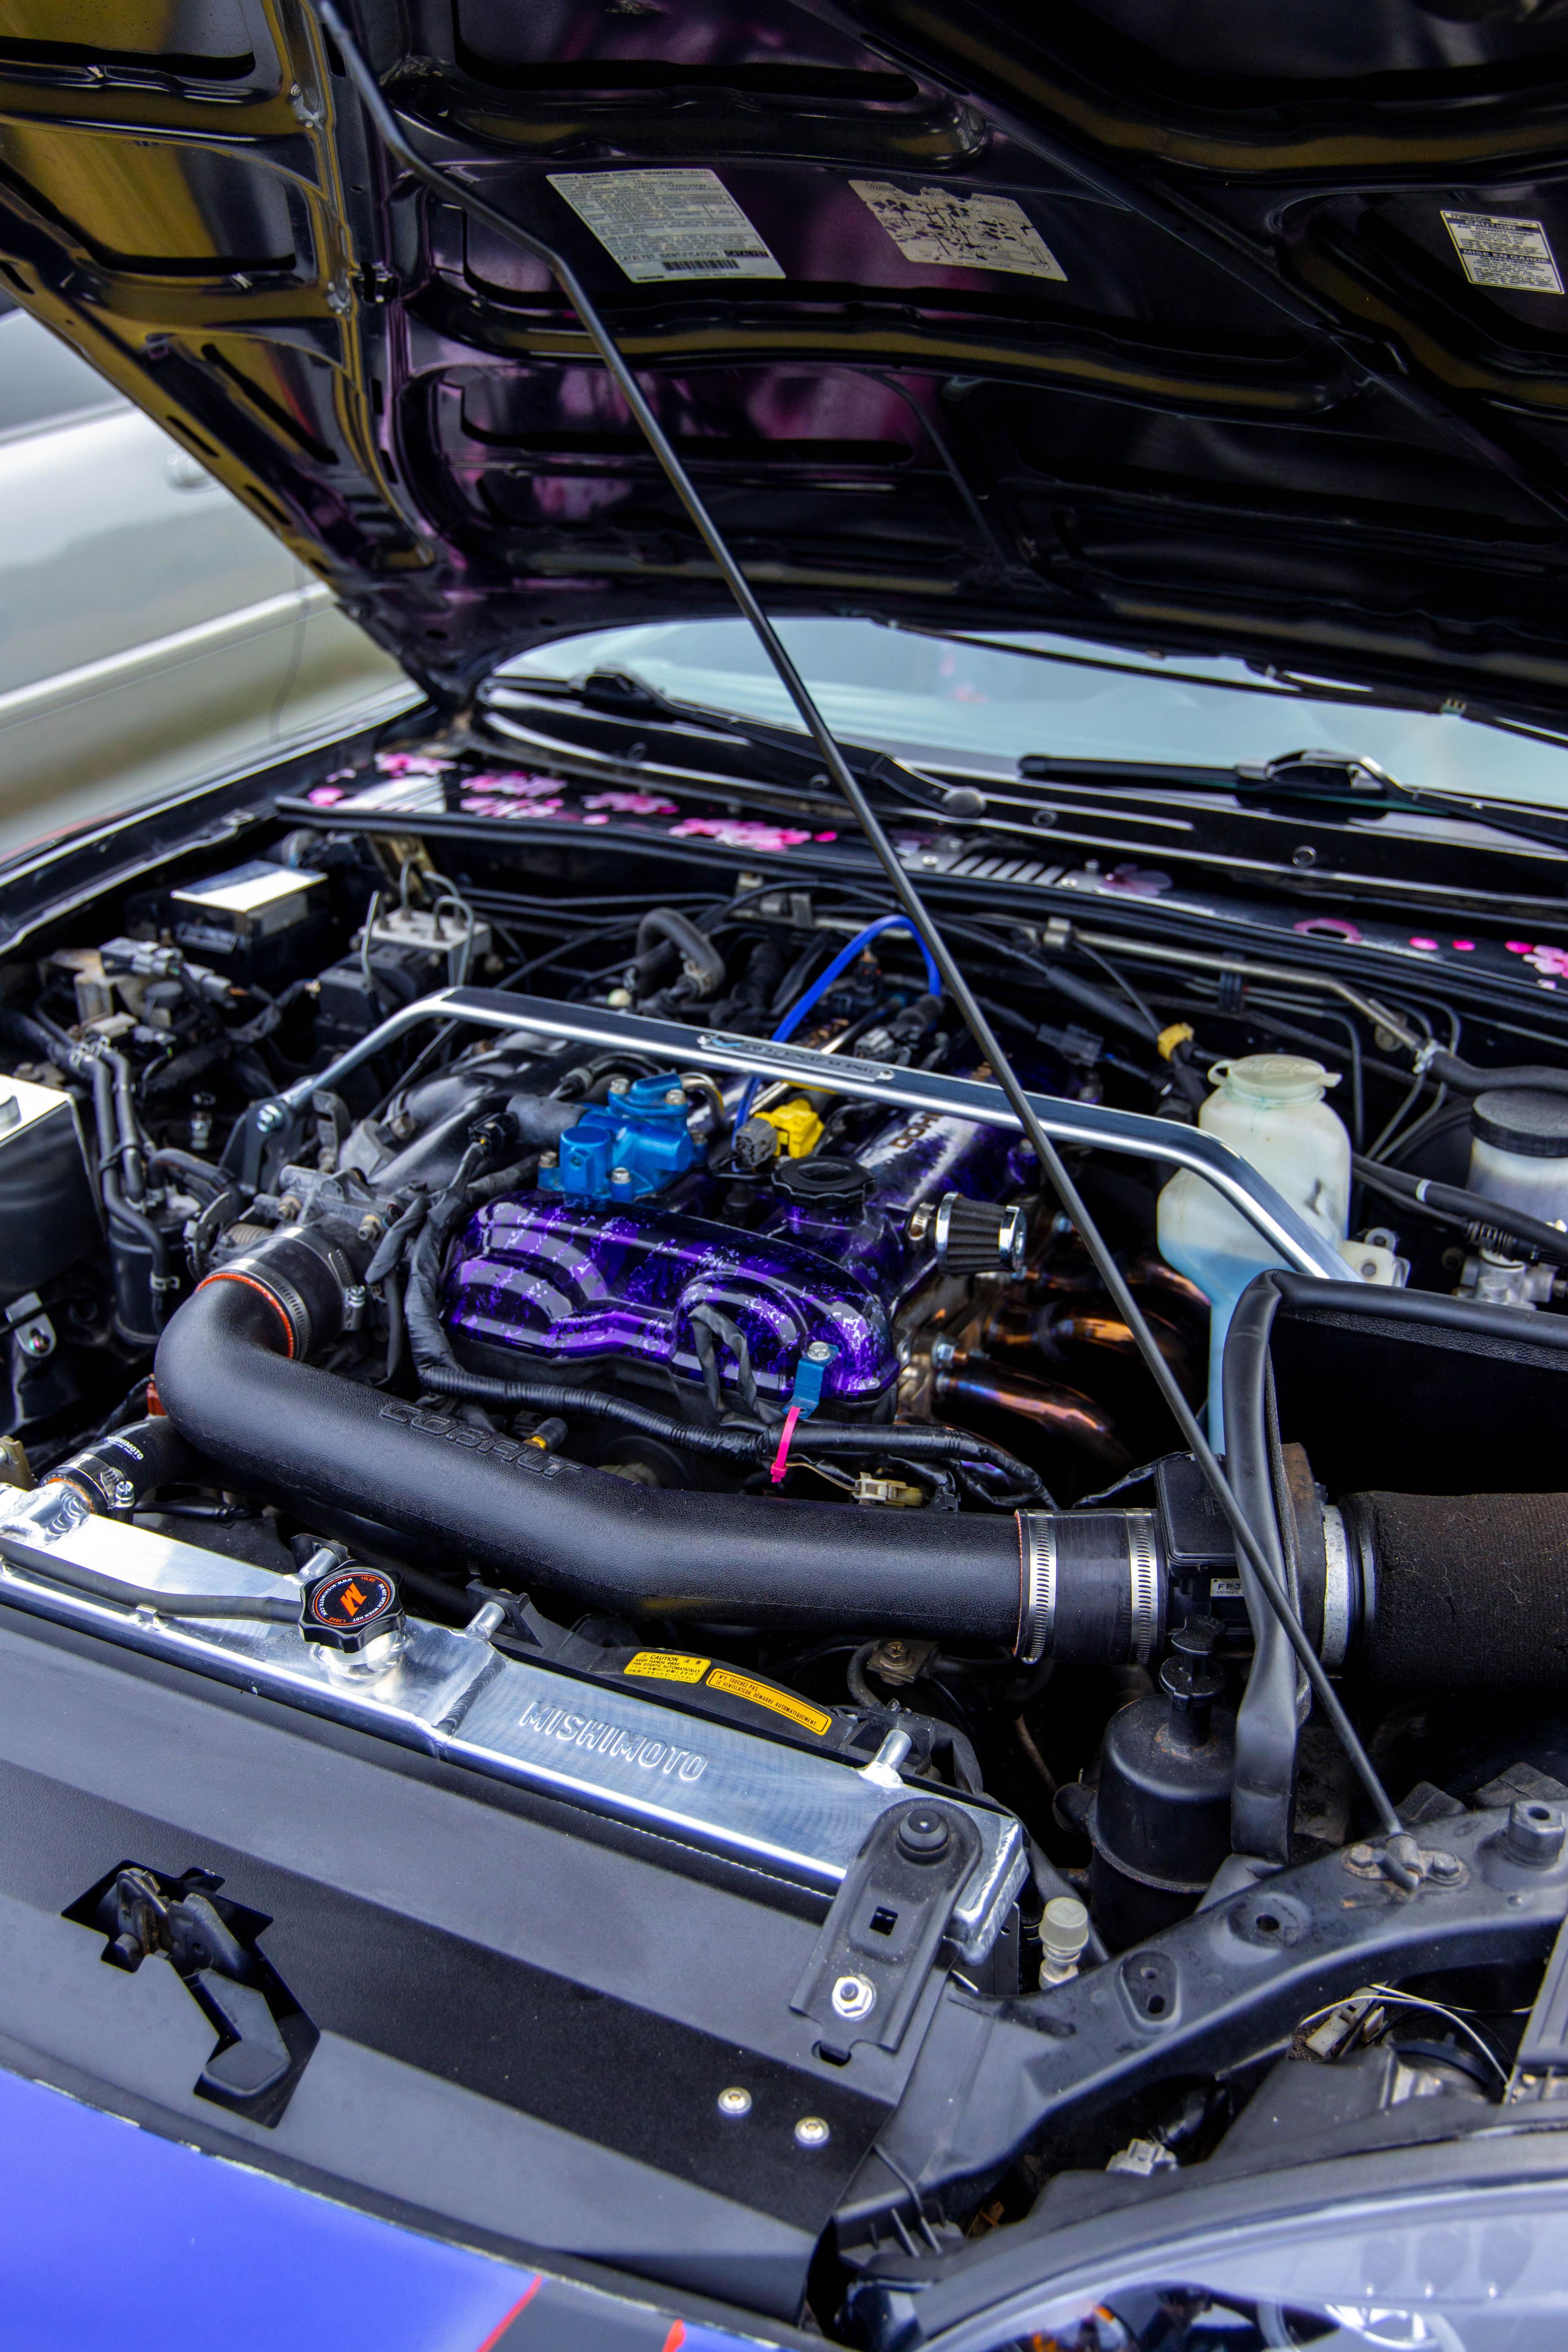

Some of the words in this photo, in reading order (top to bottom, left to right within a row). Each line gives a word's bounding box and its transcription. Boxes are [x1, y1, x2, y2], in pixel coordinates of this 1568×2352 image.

[1465, 220, 1516, 230] CAUTION
[1476, 227, 1535, 237] CONDITIONER
[1480, 256, 1535, 266] CLIMATISEUR
[1510, 255, 1549, 263] GARDE
[379, 1401, 583, 1479] COBALT
[319, 1577, 353, 1616] WWW.MISHIMOTO.COM
[364, 1608, 379, 1617] WHEN
[729, 1677, 749, 1688] TOUCHEZ
[723, 1682, 751, 1695] VENTILATEUR
[753, 1693, 774, 1705] DÉMARRE
[518, 1701, 709, 1781] MISHIMOTO
